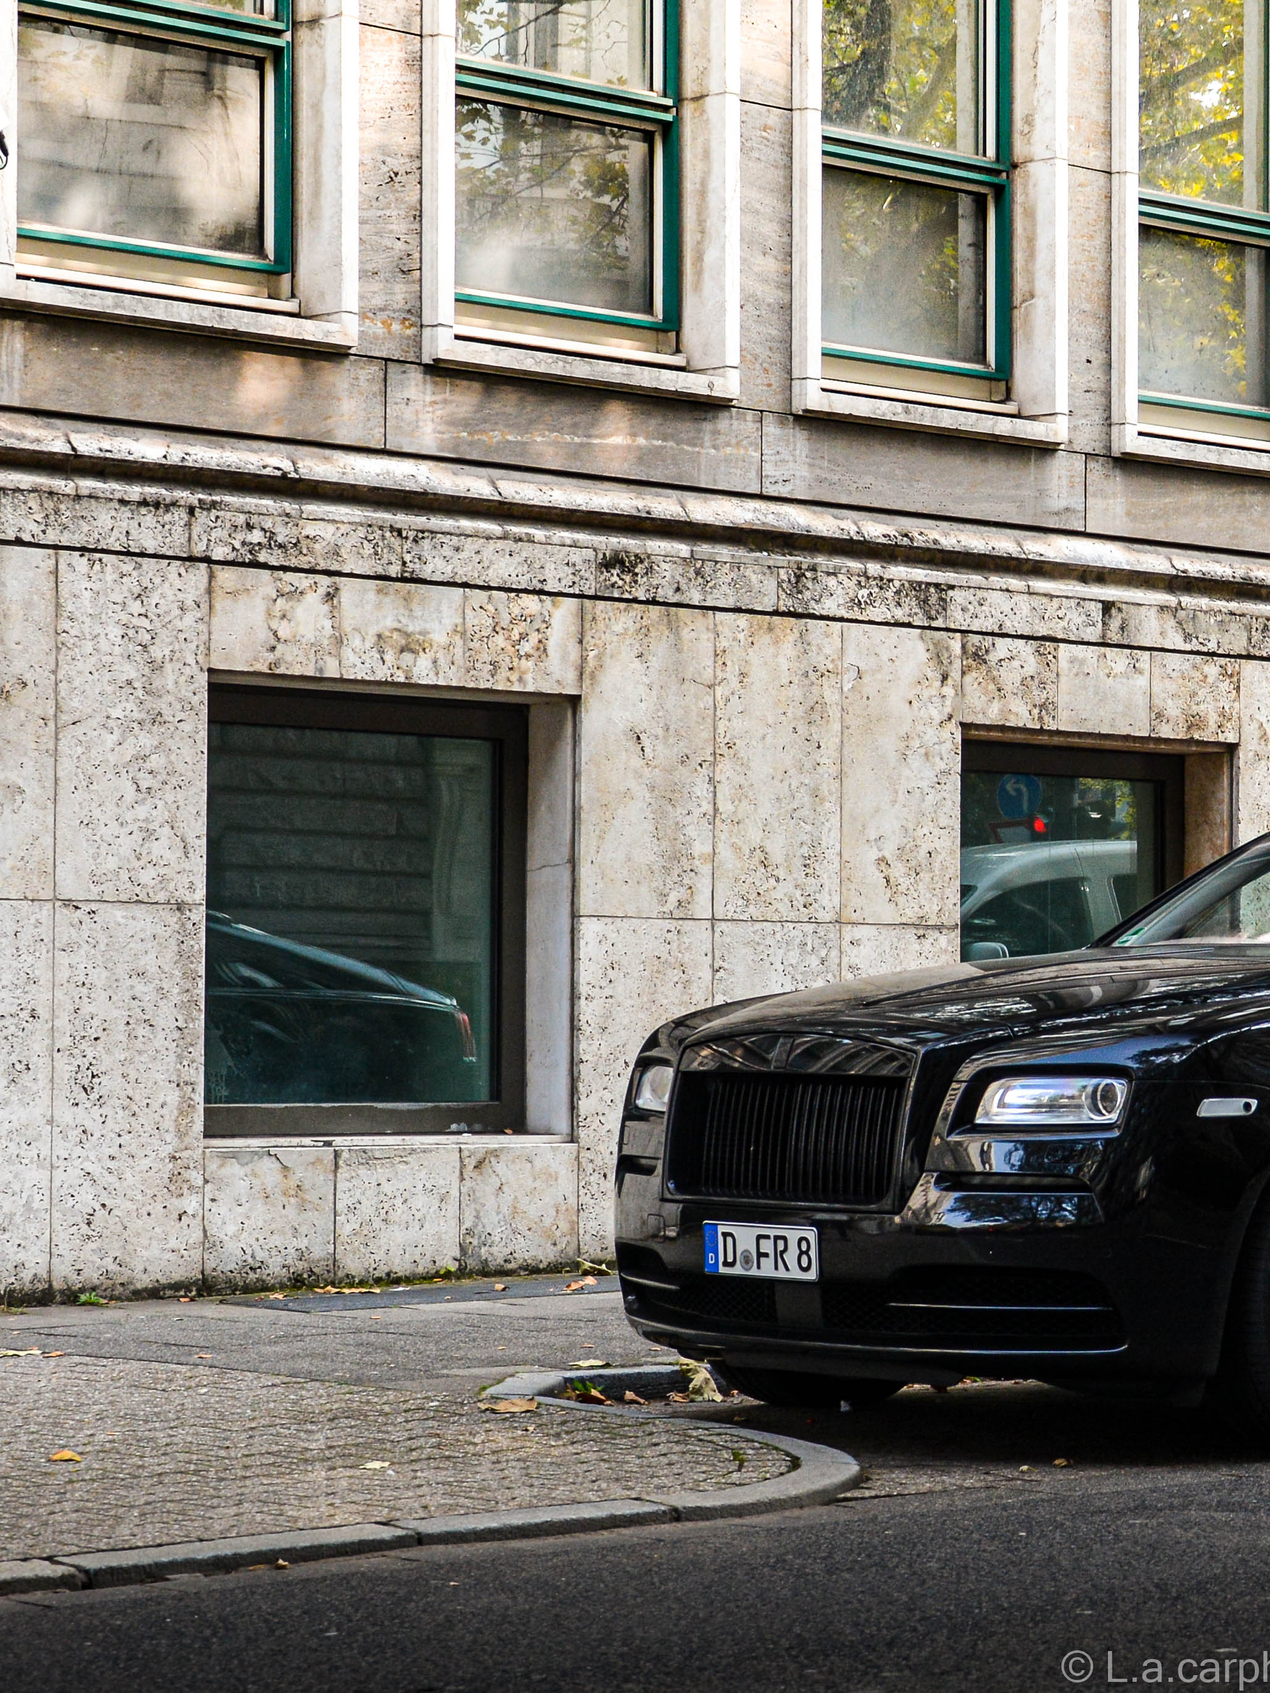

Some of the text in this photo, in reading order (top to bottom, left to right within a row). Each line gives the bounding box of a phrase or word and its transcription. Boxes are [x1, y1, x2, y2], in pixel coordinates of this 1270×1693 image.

[720, 1231, 812, 1272] D FR 8
